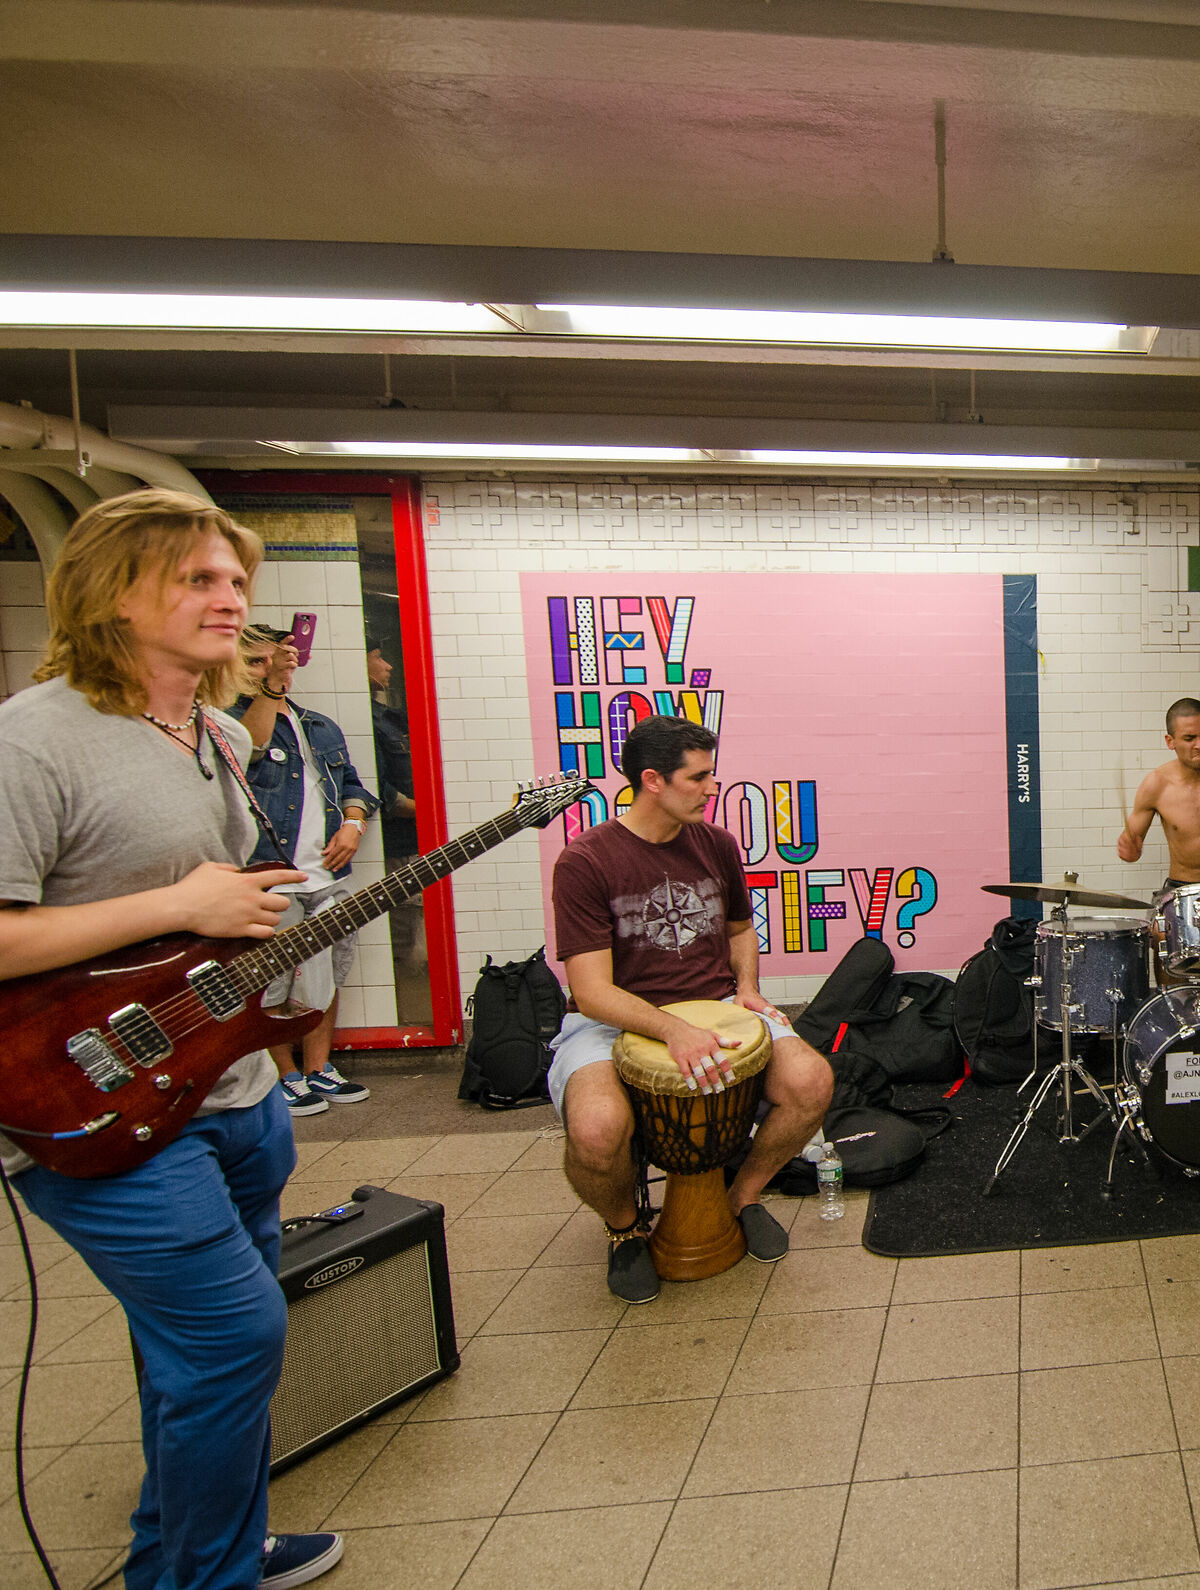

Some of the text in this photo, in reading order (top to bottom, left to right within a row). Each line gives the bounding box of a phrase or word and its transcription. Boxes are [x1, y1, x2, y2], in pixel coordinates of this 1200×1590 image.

[547, 596, 712, 688] HEY,
[1017, 744, 1030, 803] HARRY'S
[702, 780, 819, 866] OU
[312, 1260, 357, 1285] KUSTOM
